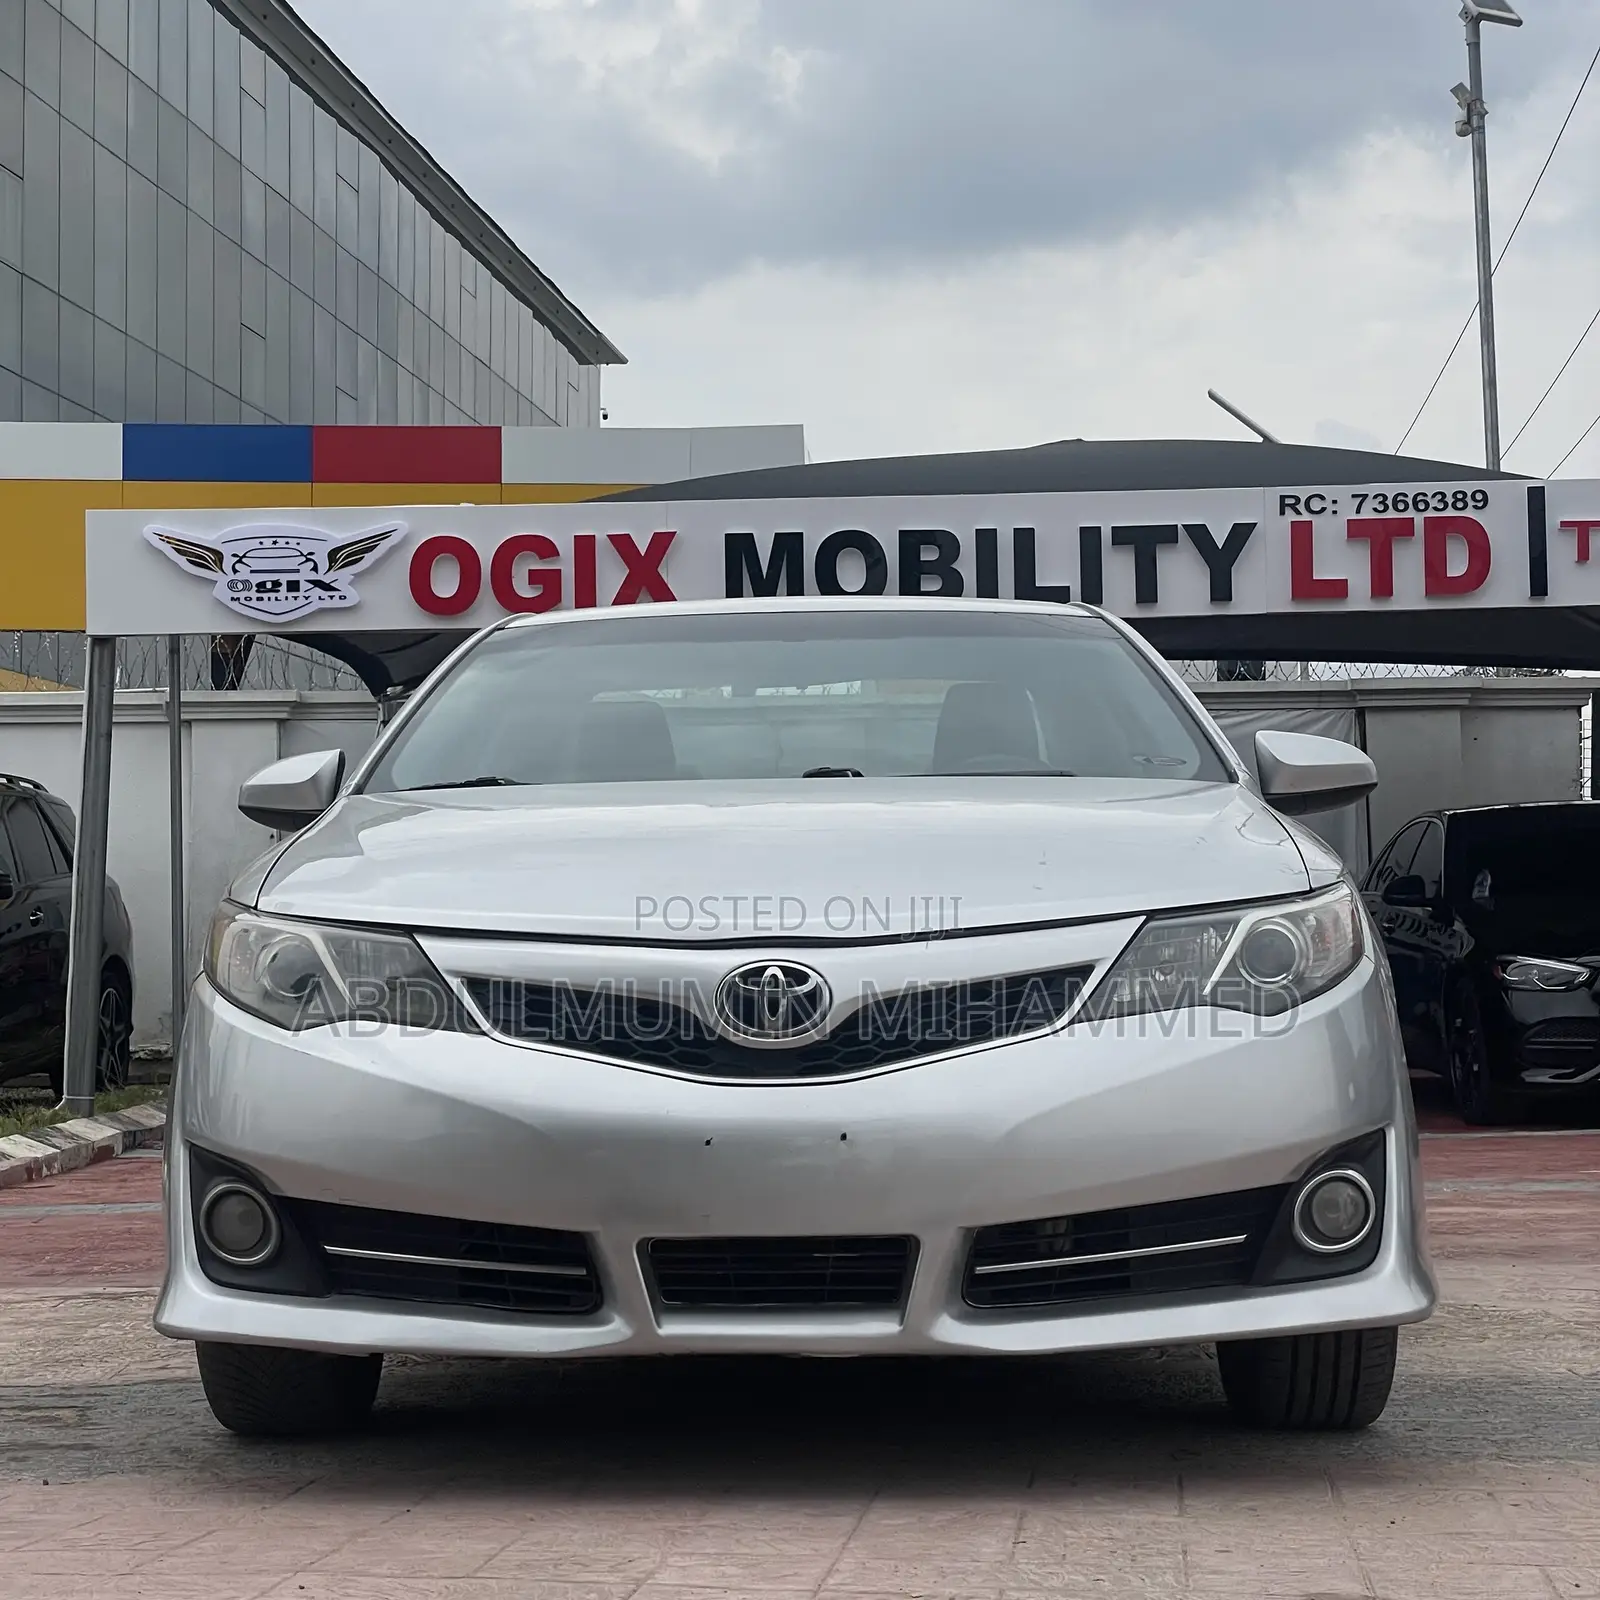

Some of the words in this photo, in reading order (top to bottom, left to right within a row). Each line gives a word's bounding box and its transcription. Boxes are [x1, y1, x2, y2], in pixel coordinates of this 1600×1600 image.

[1279, 495, 1338, 516] RC:
[1351, 489, 1489, 513] 7366389
[408, 531, 678, 616] OGIX
[724, 522, 1258, 605] MOBILITY
[1290, 515, 1492, 600] LTD
